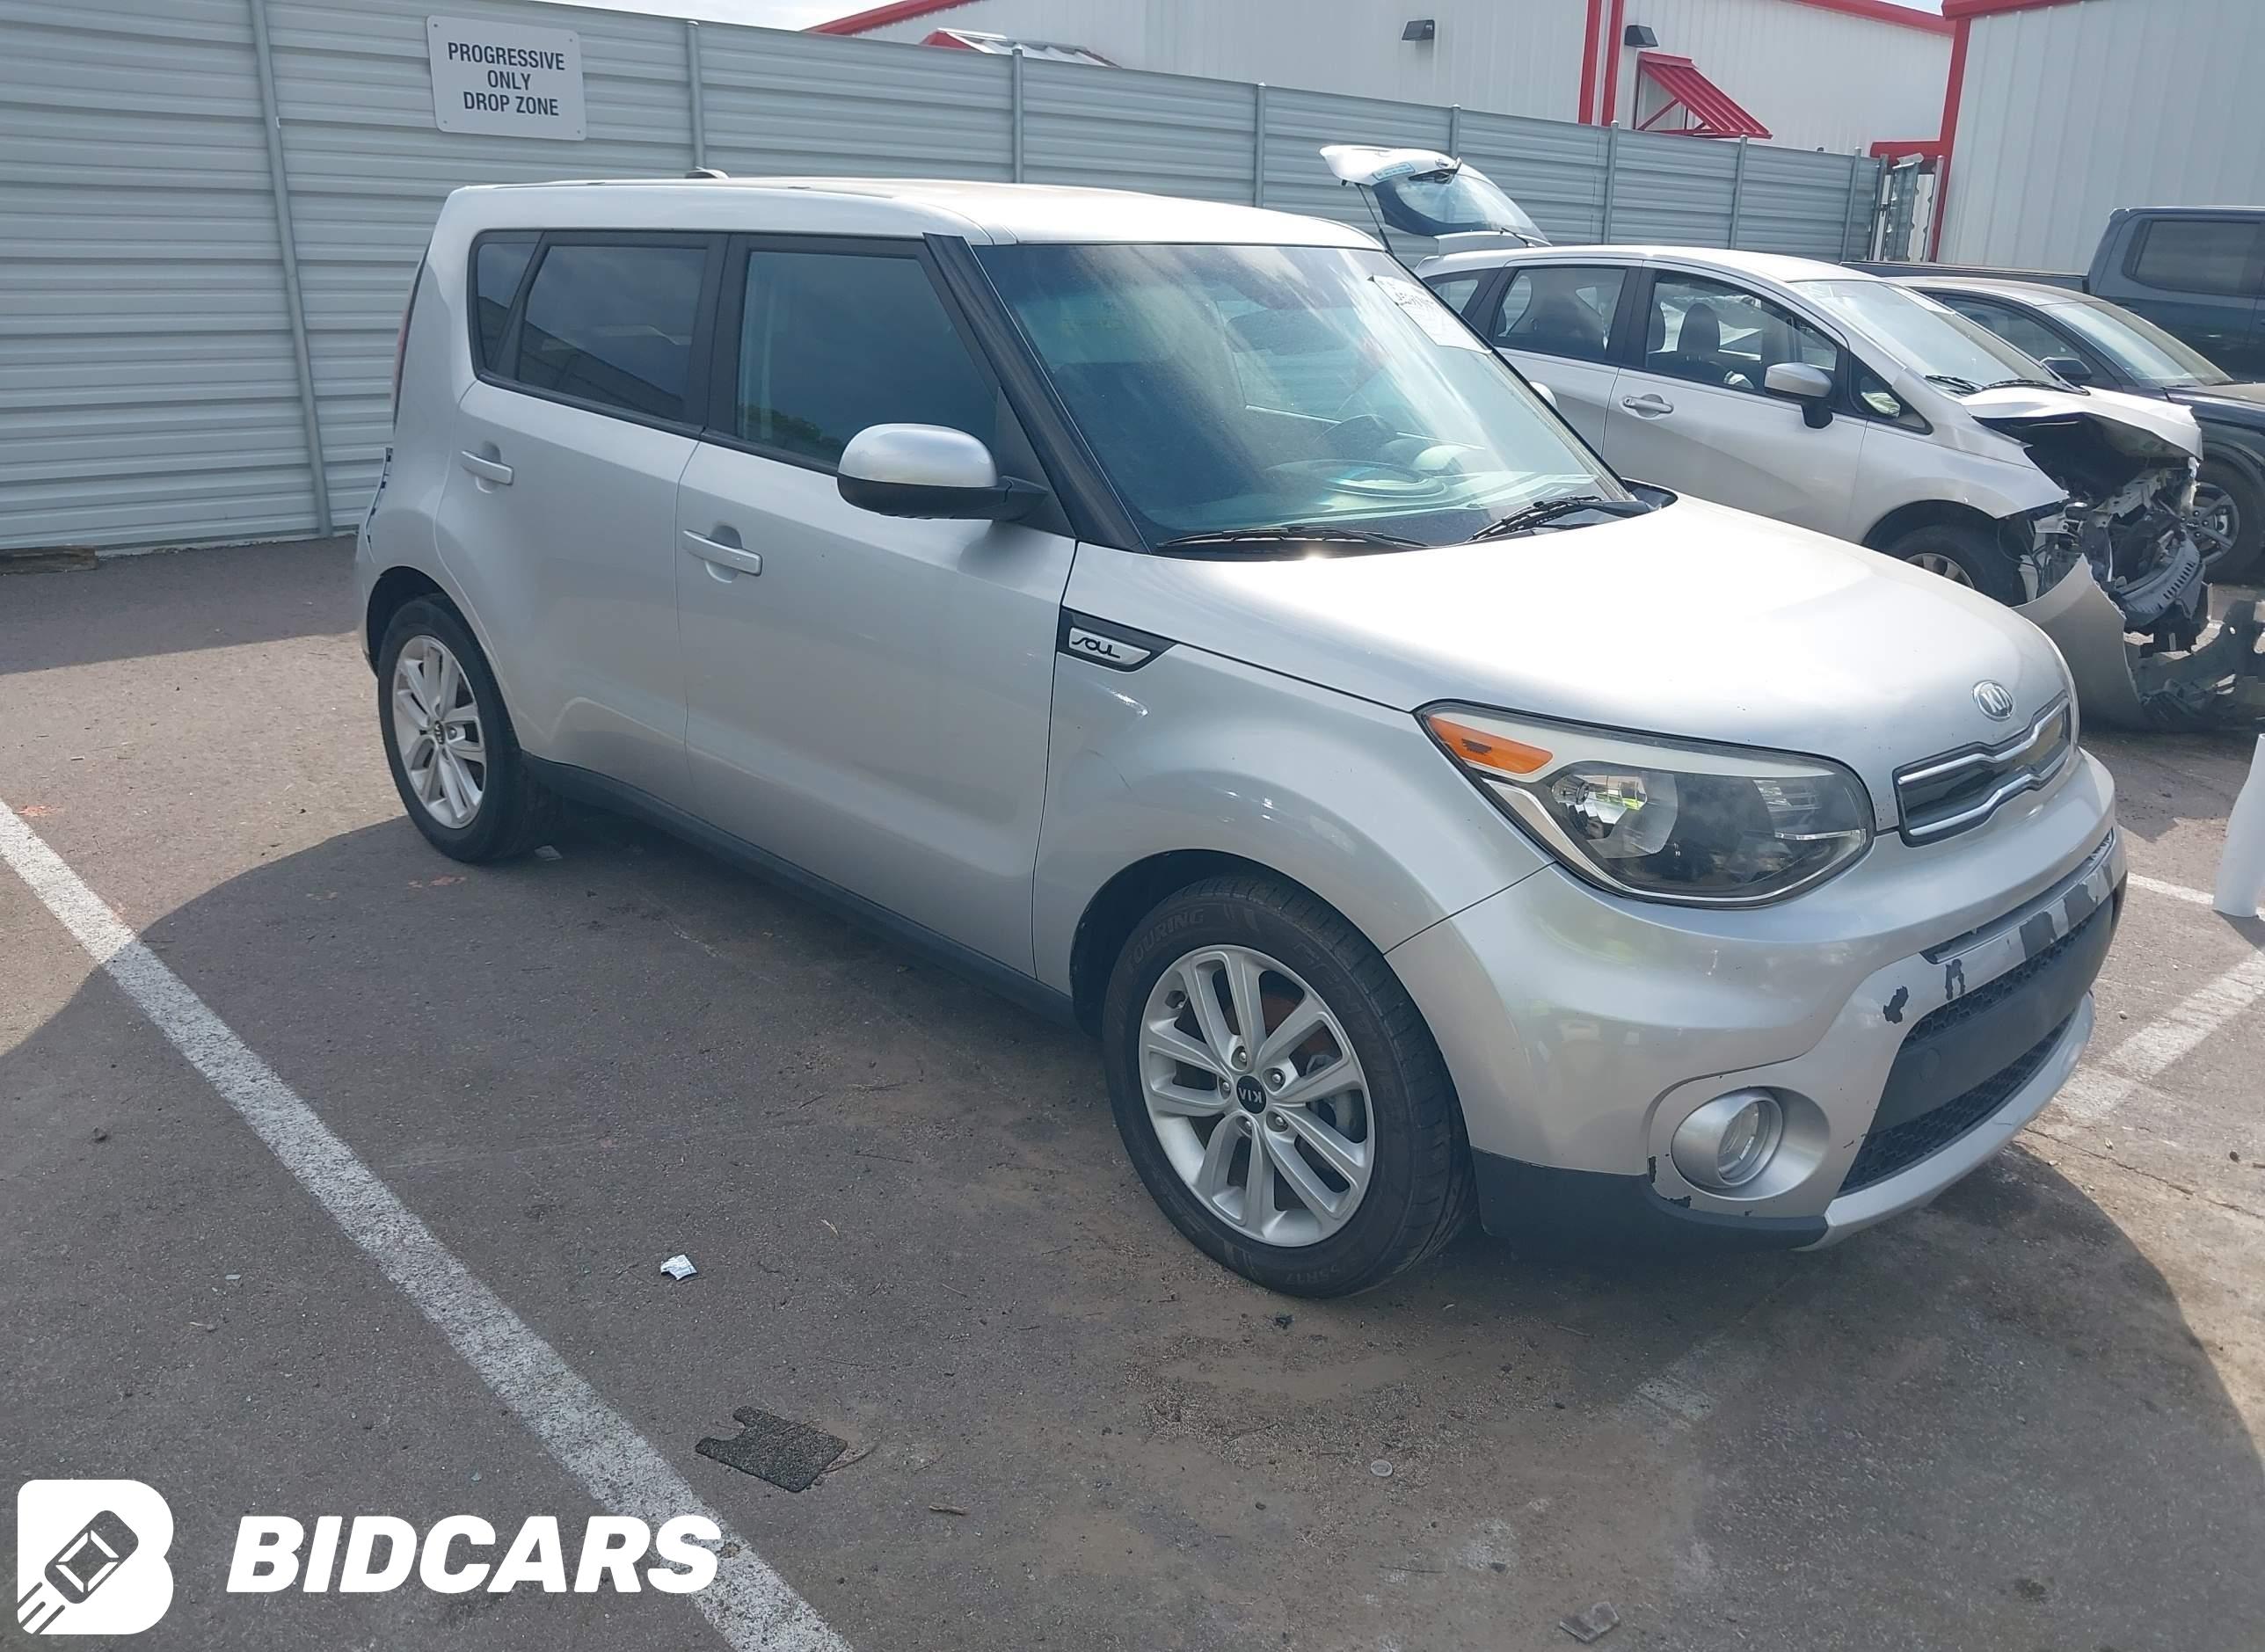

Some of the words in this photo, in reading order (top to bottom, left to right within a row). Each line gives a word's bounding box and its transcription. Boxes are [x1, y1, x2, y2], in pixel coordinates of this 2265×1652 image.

[448, 42, 565, 70] PROGRESSIVE
[487, 70, 531, 91] ONLY
[463, 91, 510, 112] DROP
[515, 96, 559, 116] ZONE
[1238, 1087, 1263, 1103] KIA
